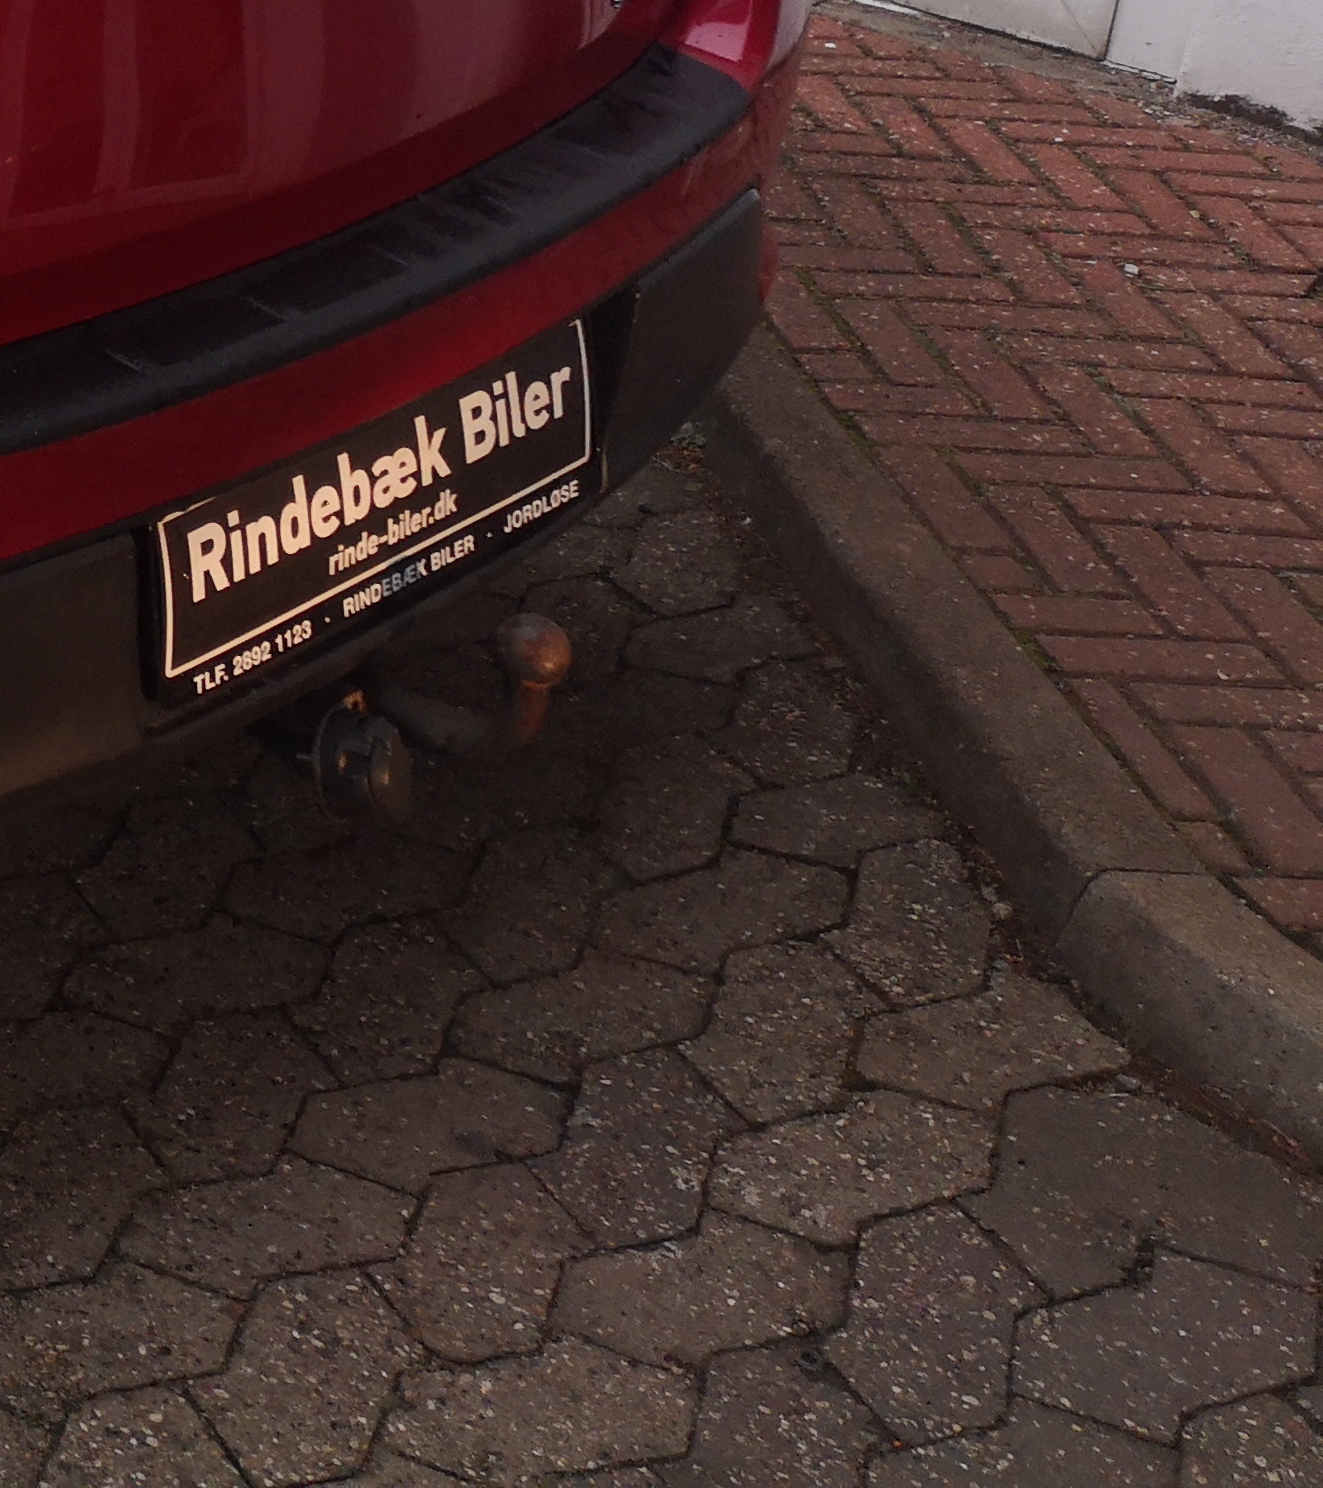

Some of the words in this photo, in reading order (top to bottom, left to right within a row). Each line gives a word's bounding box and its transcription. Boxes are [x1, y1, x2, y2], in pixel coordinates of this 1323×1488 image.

[186, 415, 452, 604] Rindebæk
[458, 366, 572, 465] Biler
[193, 663, 230, 694] TLF.
[342, 558, 429, 618] RINDEBÆK
[430, 535, 475, 572] BILER
[503, 479, 580, 534] JORDLØSE
[328, 489, 458, 576] rinde-biler.dk
